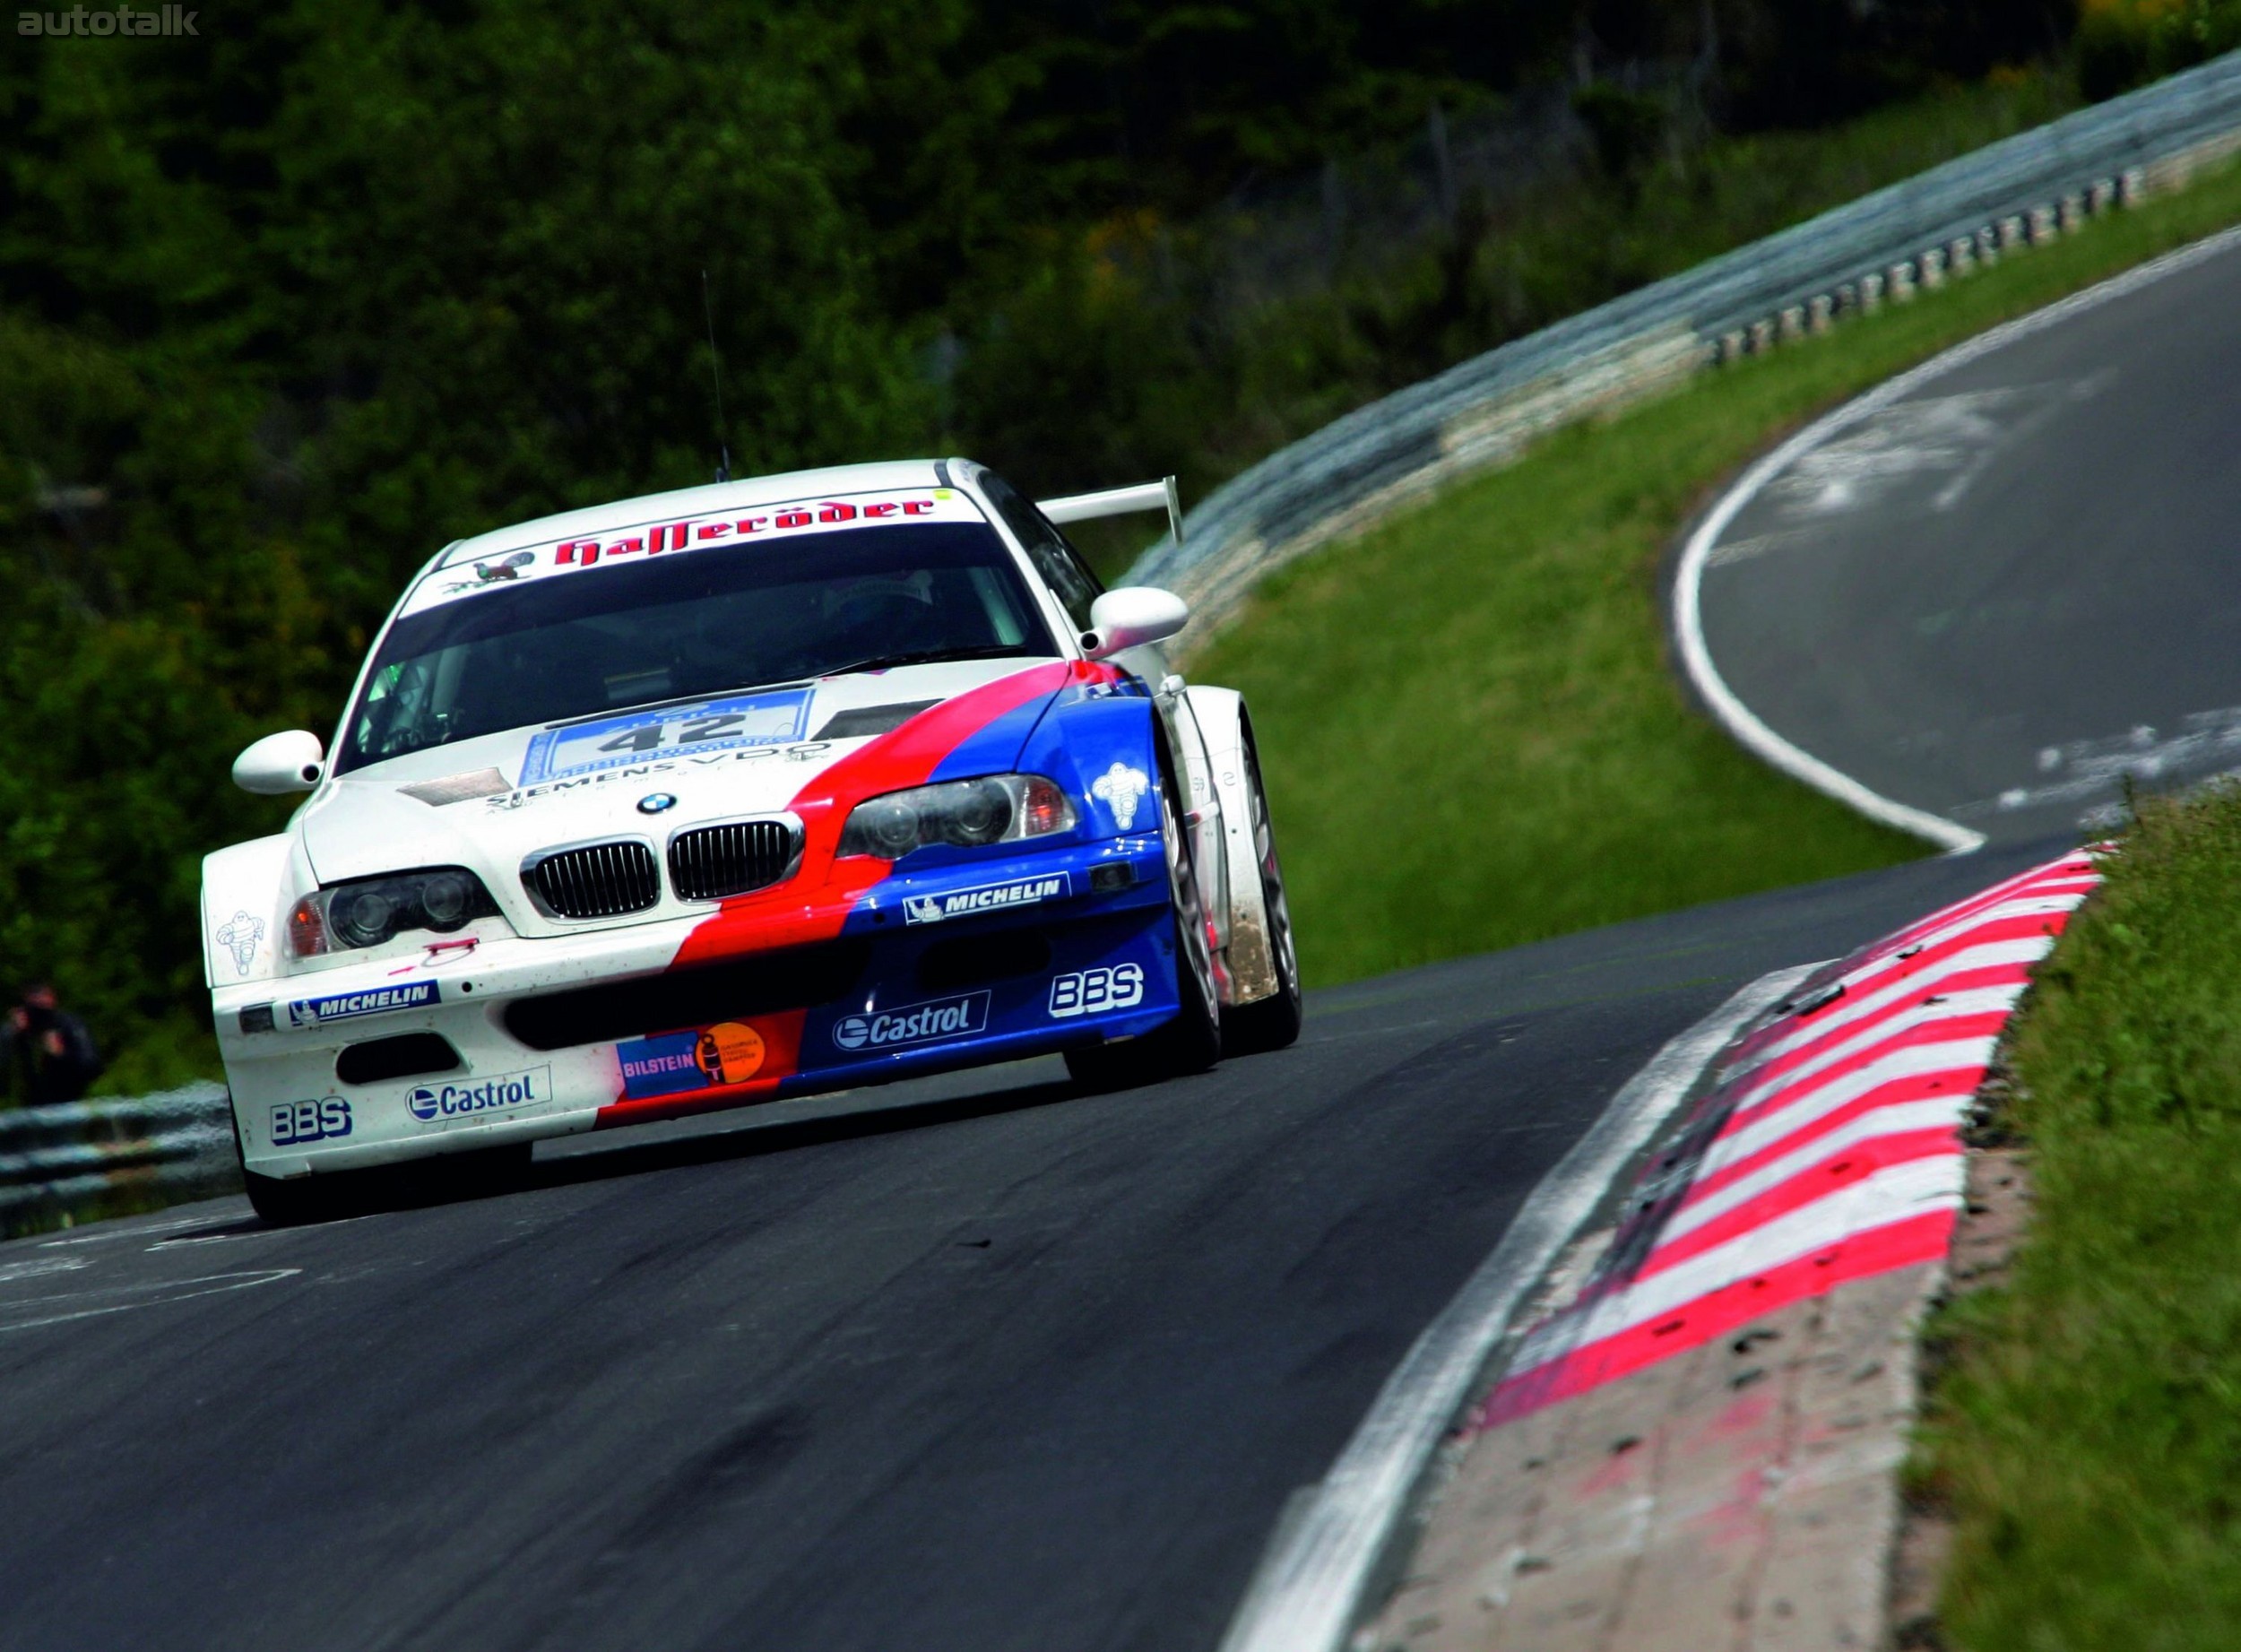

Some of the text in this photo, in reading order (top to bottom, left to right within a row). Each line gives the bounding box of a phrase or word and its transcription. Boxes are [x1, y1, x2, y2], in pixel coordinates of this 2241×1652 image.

[597, 714, 747, 752] 42
[486, 762, 675, 806] SIEMENS
[687, 742, 831, 765] VDO
[945, 878, 1060, 913] MICHELIN
[319, 983, 429, 1017] MICHELIN
[1048, 962, 1144, 1018] BBS
[870, 999, 970, 1044] Castrol
[622, 1052, 696, 1078] BILSTEIN
[439, 1075, 535, 1116] Castrol
[271, 1095, 352, 1146] BBS
